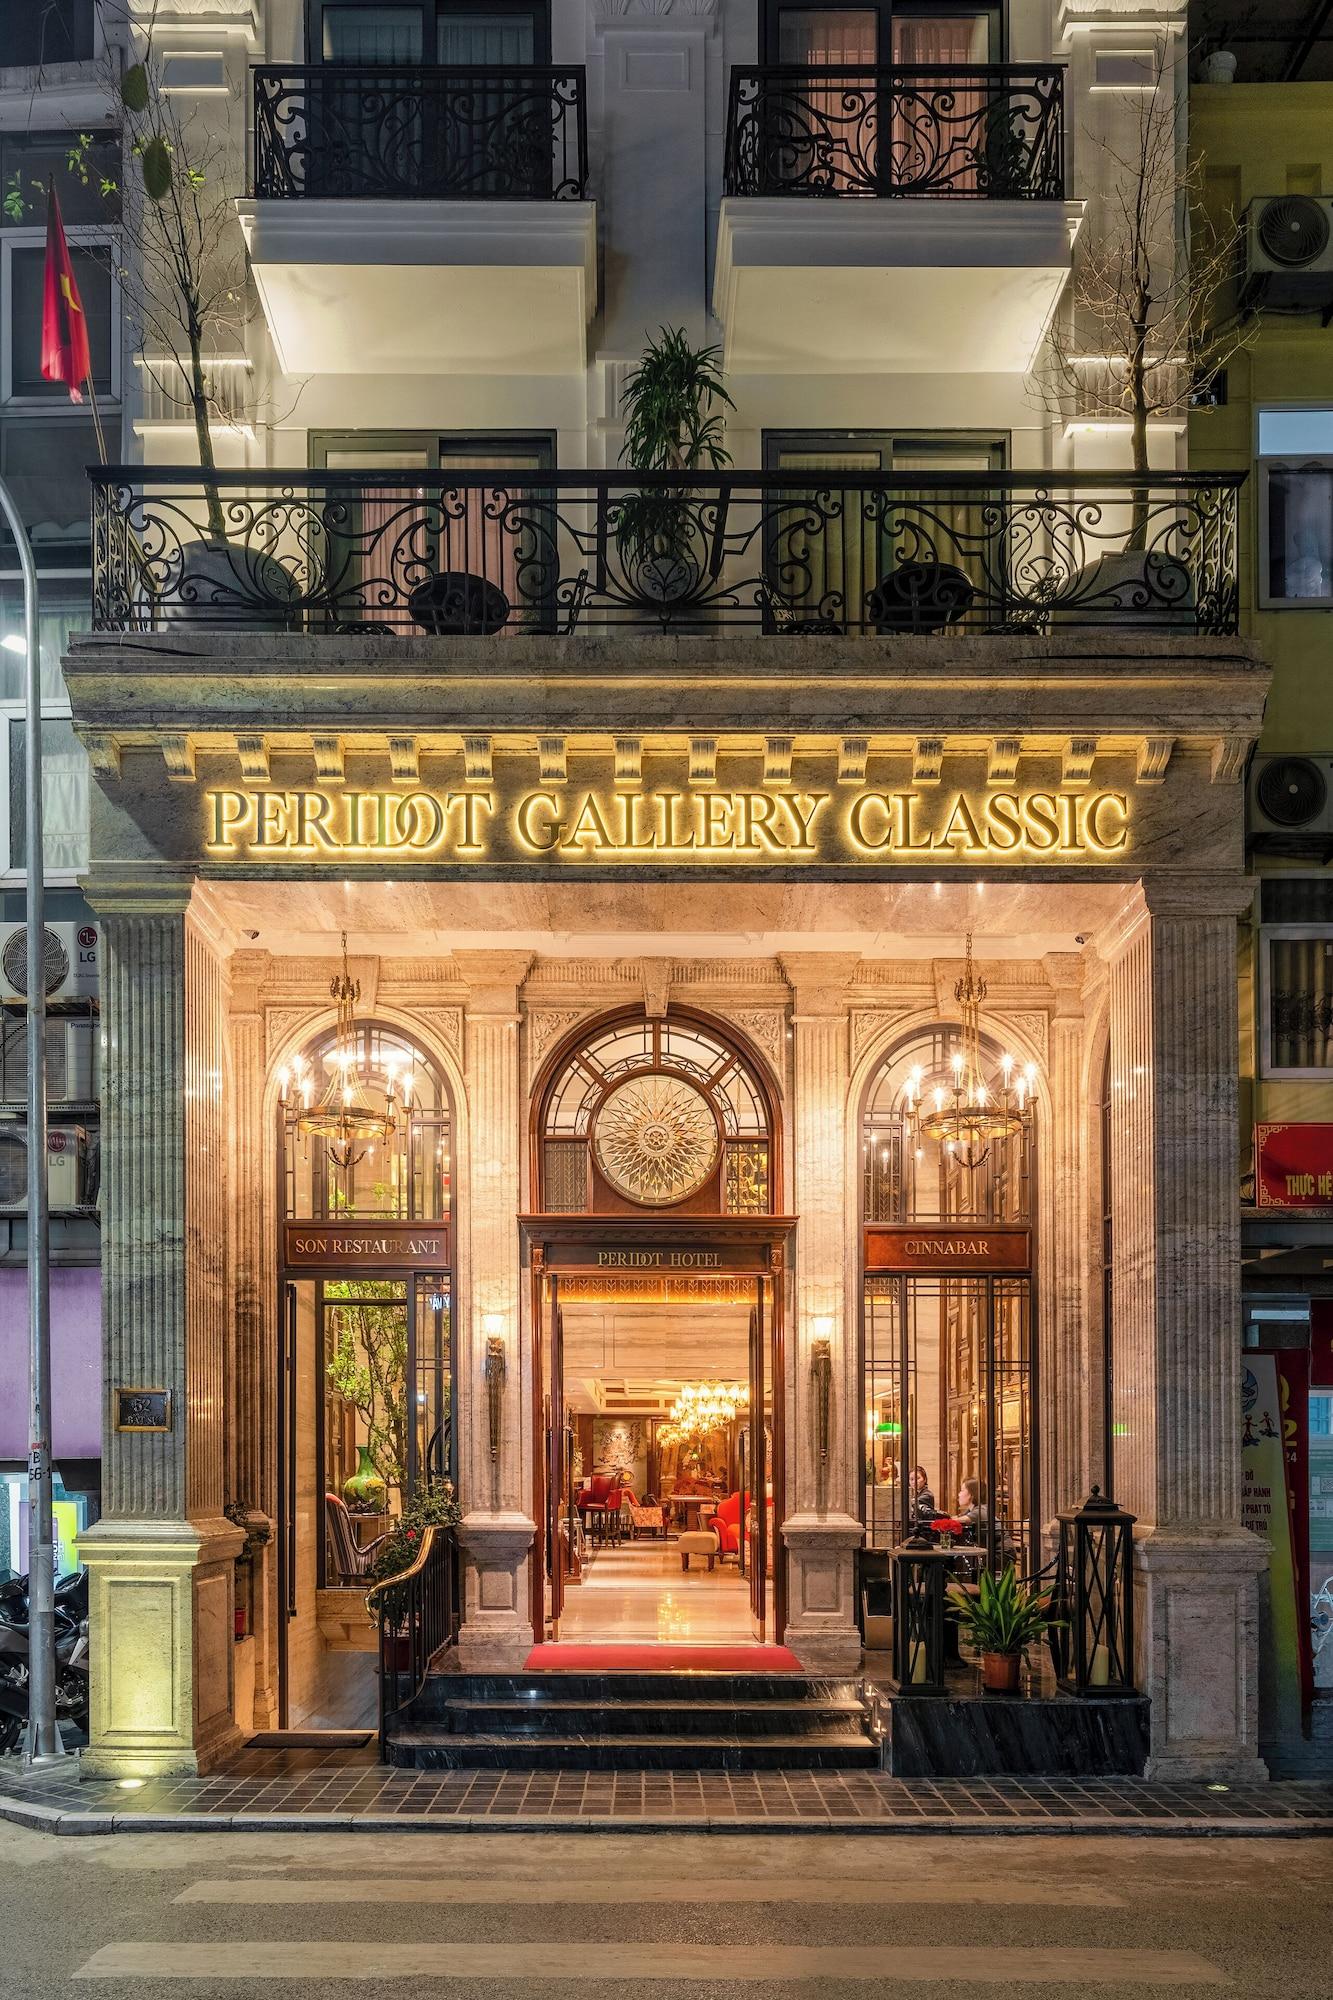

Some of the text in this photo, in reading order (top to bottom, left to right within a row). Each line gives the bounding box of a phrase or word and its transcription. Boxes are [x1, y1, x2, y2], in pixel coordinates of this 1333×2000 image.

[207, 791, 1128, 850] PERIDOT GALLERY CLASSIC
[79, 951, 96, 962] LG
[49, 1155, 65, 1167] LG
[295, 1239, 440, 1254] SON RESTAURANT
[904, 1240, 990, 1255] CINNABAR
[598, 1252, 723, 1267] PERIDOT HOTEL
